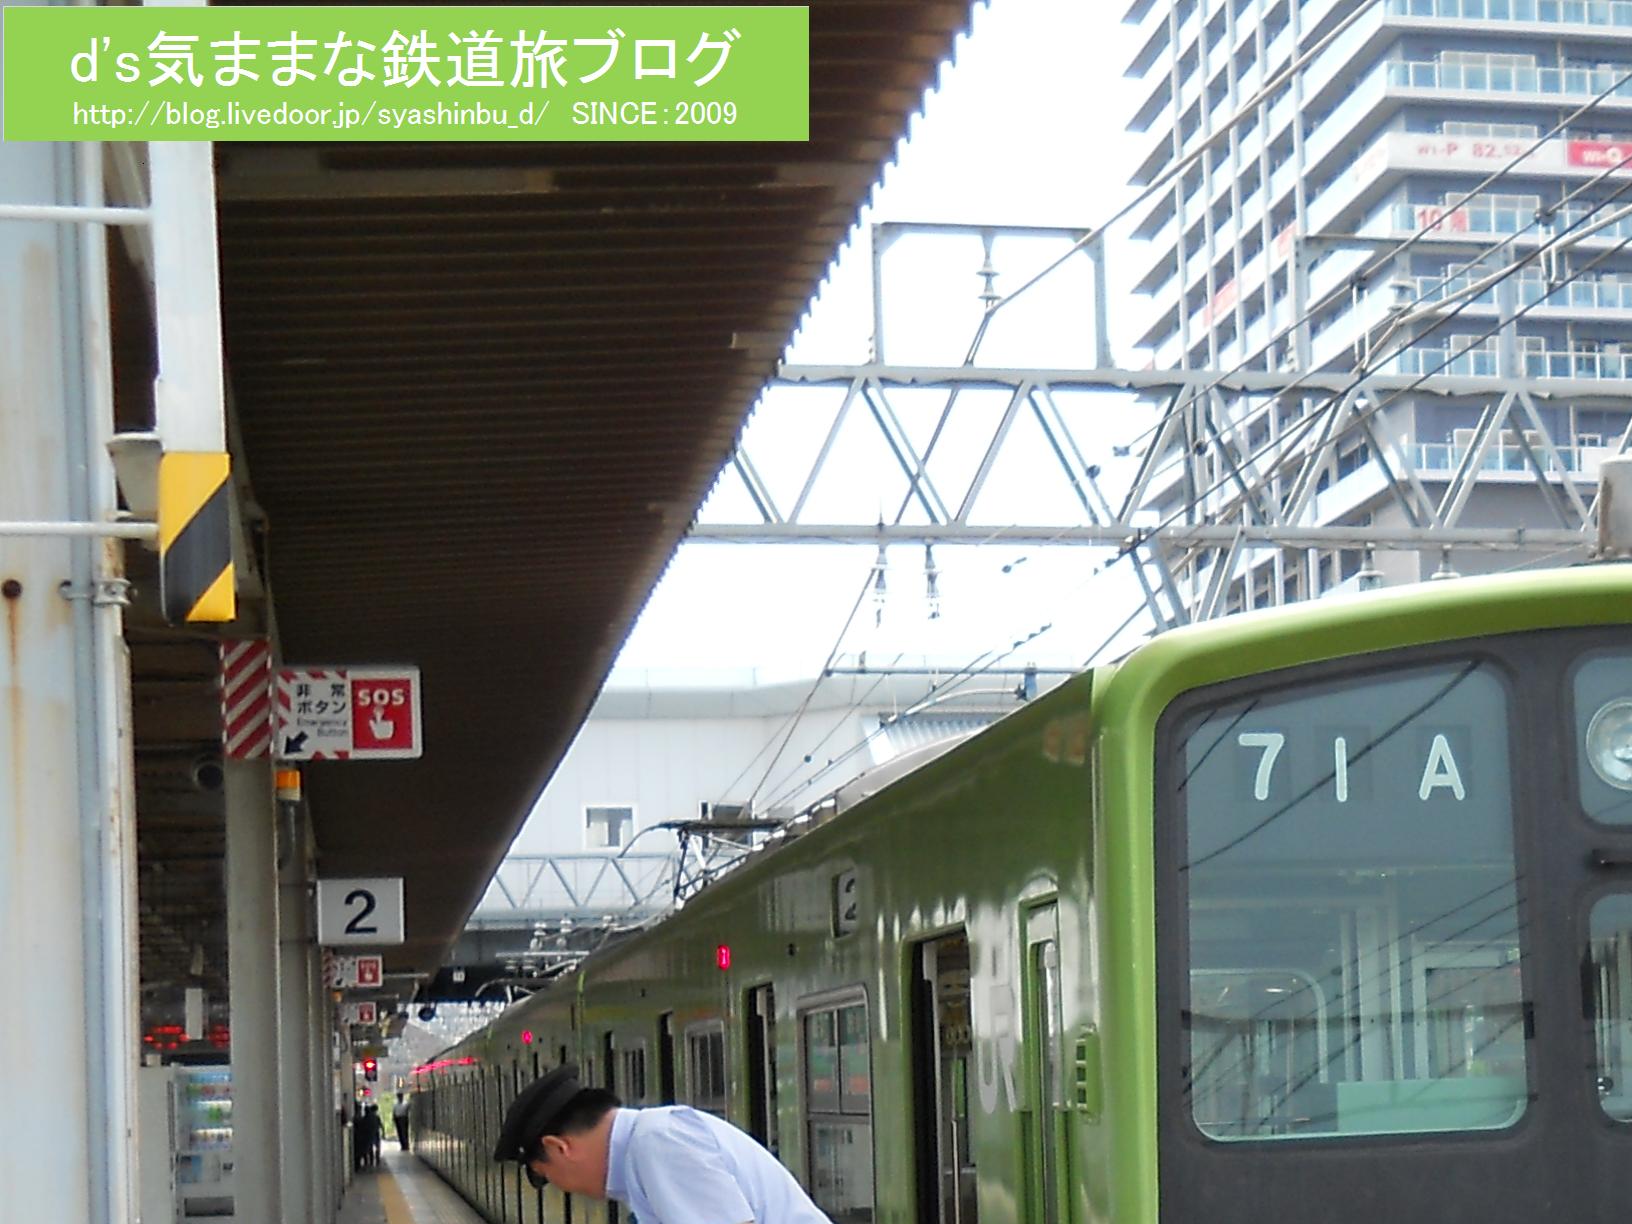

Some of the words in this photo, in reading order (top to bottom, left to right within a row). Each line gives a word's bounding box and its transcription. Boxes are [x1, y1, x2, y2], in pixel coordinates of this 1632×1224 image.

[297, 701, 346, 715] ボタン
[358, 688, 405, 706] SOS
[1238, 733, 1285, 801] 7
[1418, 734, 1465, 801] A
[344, 889, 378, 935] 2
